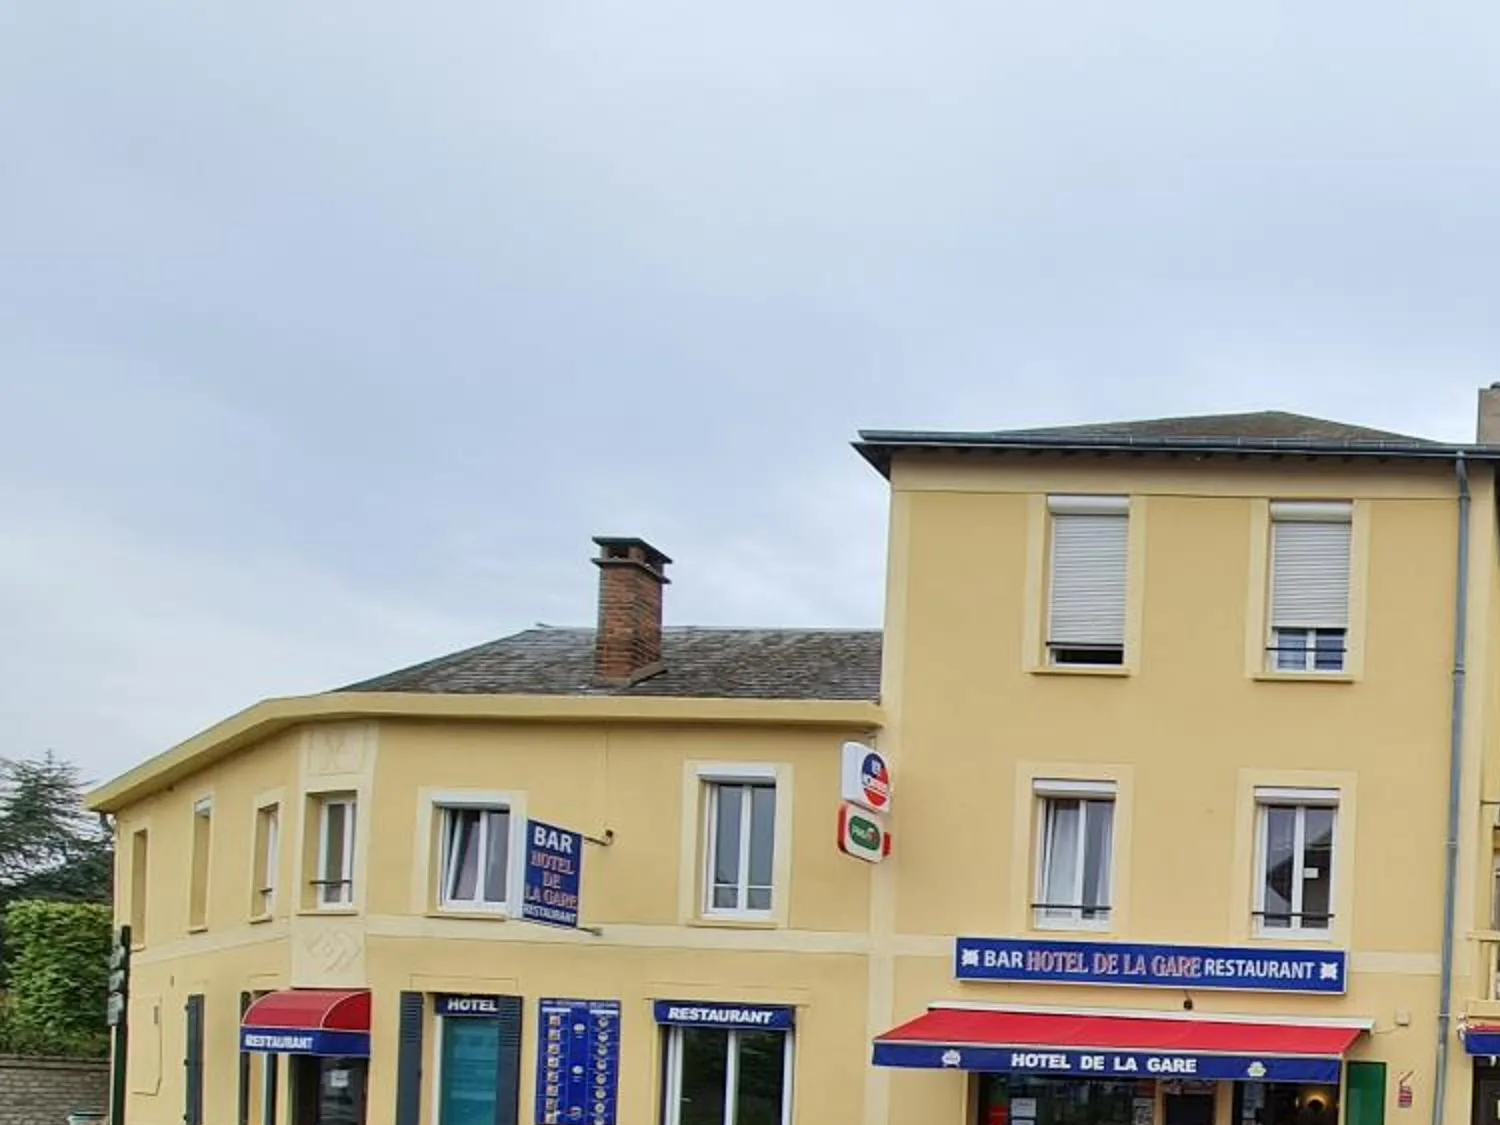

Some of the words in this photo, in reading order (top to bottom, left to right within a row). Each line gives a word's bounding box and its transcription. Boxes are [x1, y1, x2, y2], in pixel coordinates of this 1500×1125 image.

[533, 825, 573, 855] BAR
[530, 850, 575, 875] HOTEL
[543, 871, 561, 889] DE
[524, 882, 542, 902] LA
[543, 889, 577, 910] GARE
[984, 949, 1022, 969] BAR
[1025, 951, 1087, 974] HOTEL
[1094, 953, 1120, 975] DE
[1123, 954, 1147, 976] LA
[1151, 955, 1201, 979] GARE
[1204, 957, 1315, 980] RESTAURANT
[448, 998, 498, 1012] HOTEL
[667, 1007, 773, 1024] RESTAURANT
[245, 1033, 314, 1049] RESTAURANT
[1011, 1052, 1070, 1070] HOTEL
[1080, 1055, 1105, 1071] DE
[1113, 1056, 1137, 1072] LA
[1146, 1057, 1197, 1073] GARE
